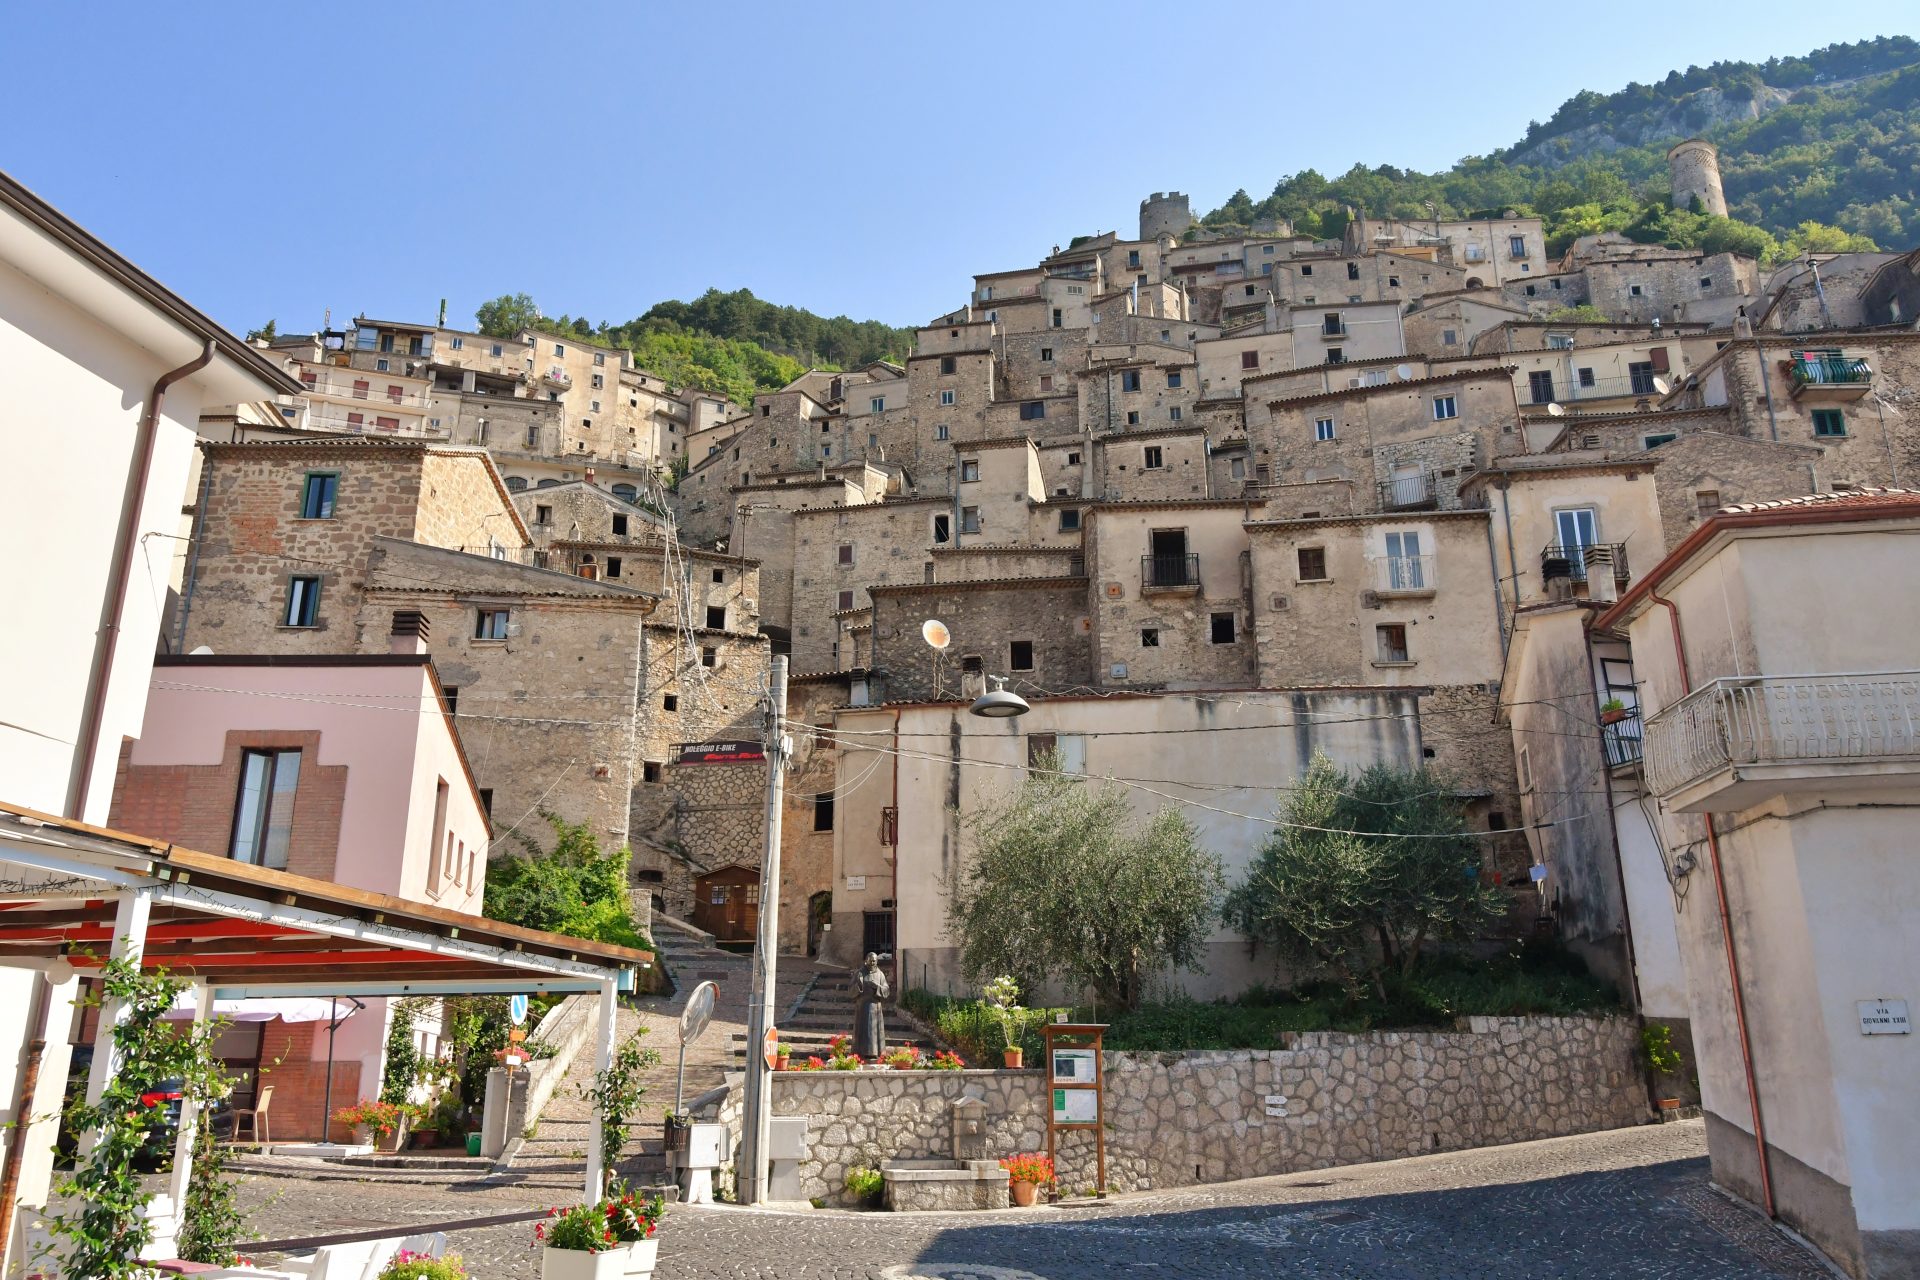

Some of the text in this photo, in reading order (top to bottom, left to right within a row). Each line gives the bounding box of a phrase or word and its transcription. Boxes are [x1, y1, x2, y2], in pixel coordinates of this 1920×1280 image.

[684, 743, 737, 753] NOLEGGIO E-BIKE
[765, 1040, 778, 1056] STO
